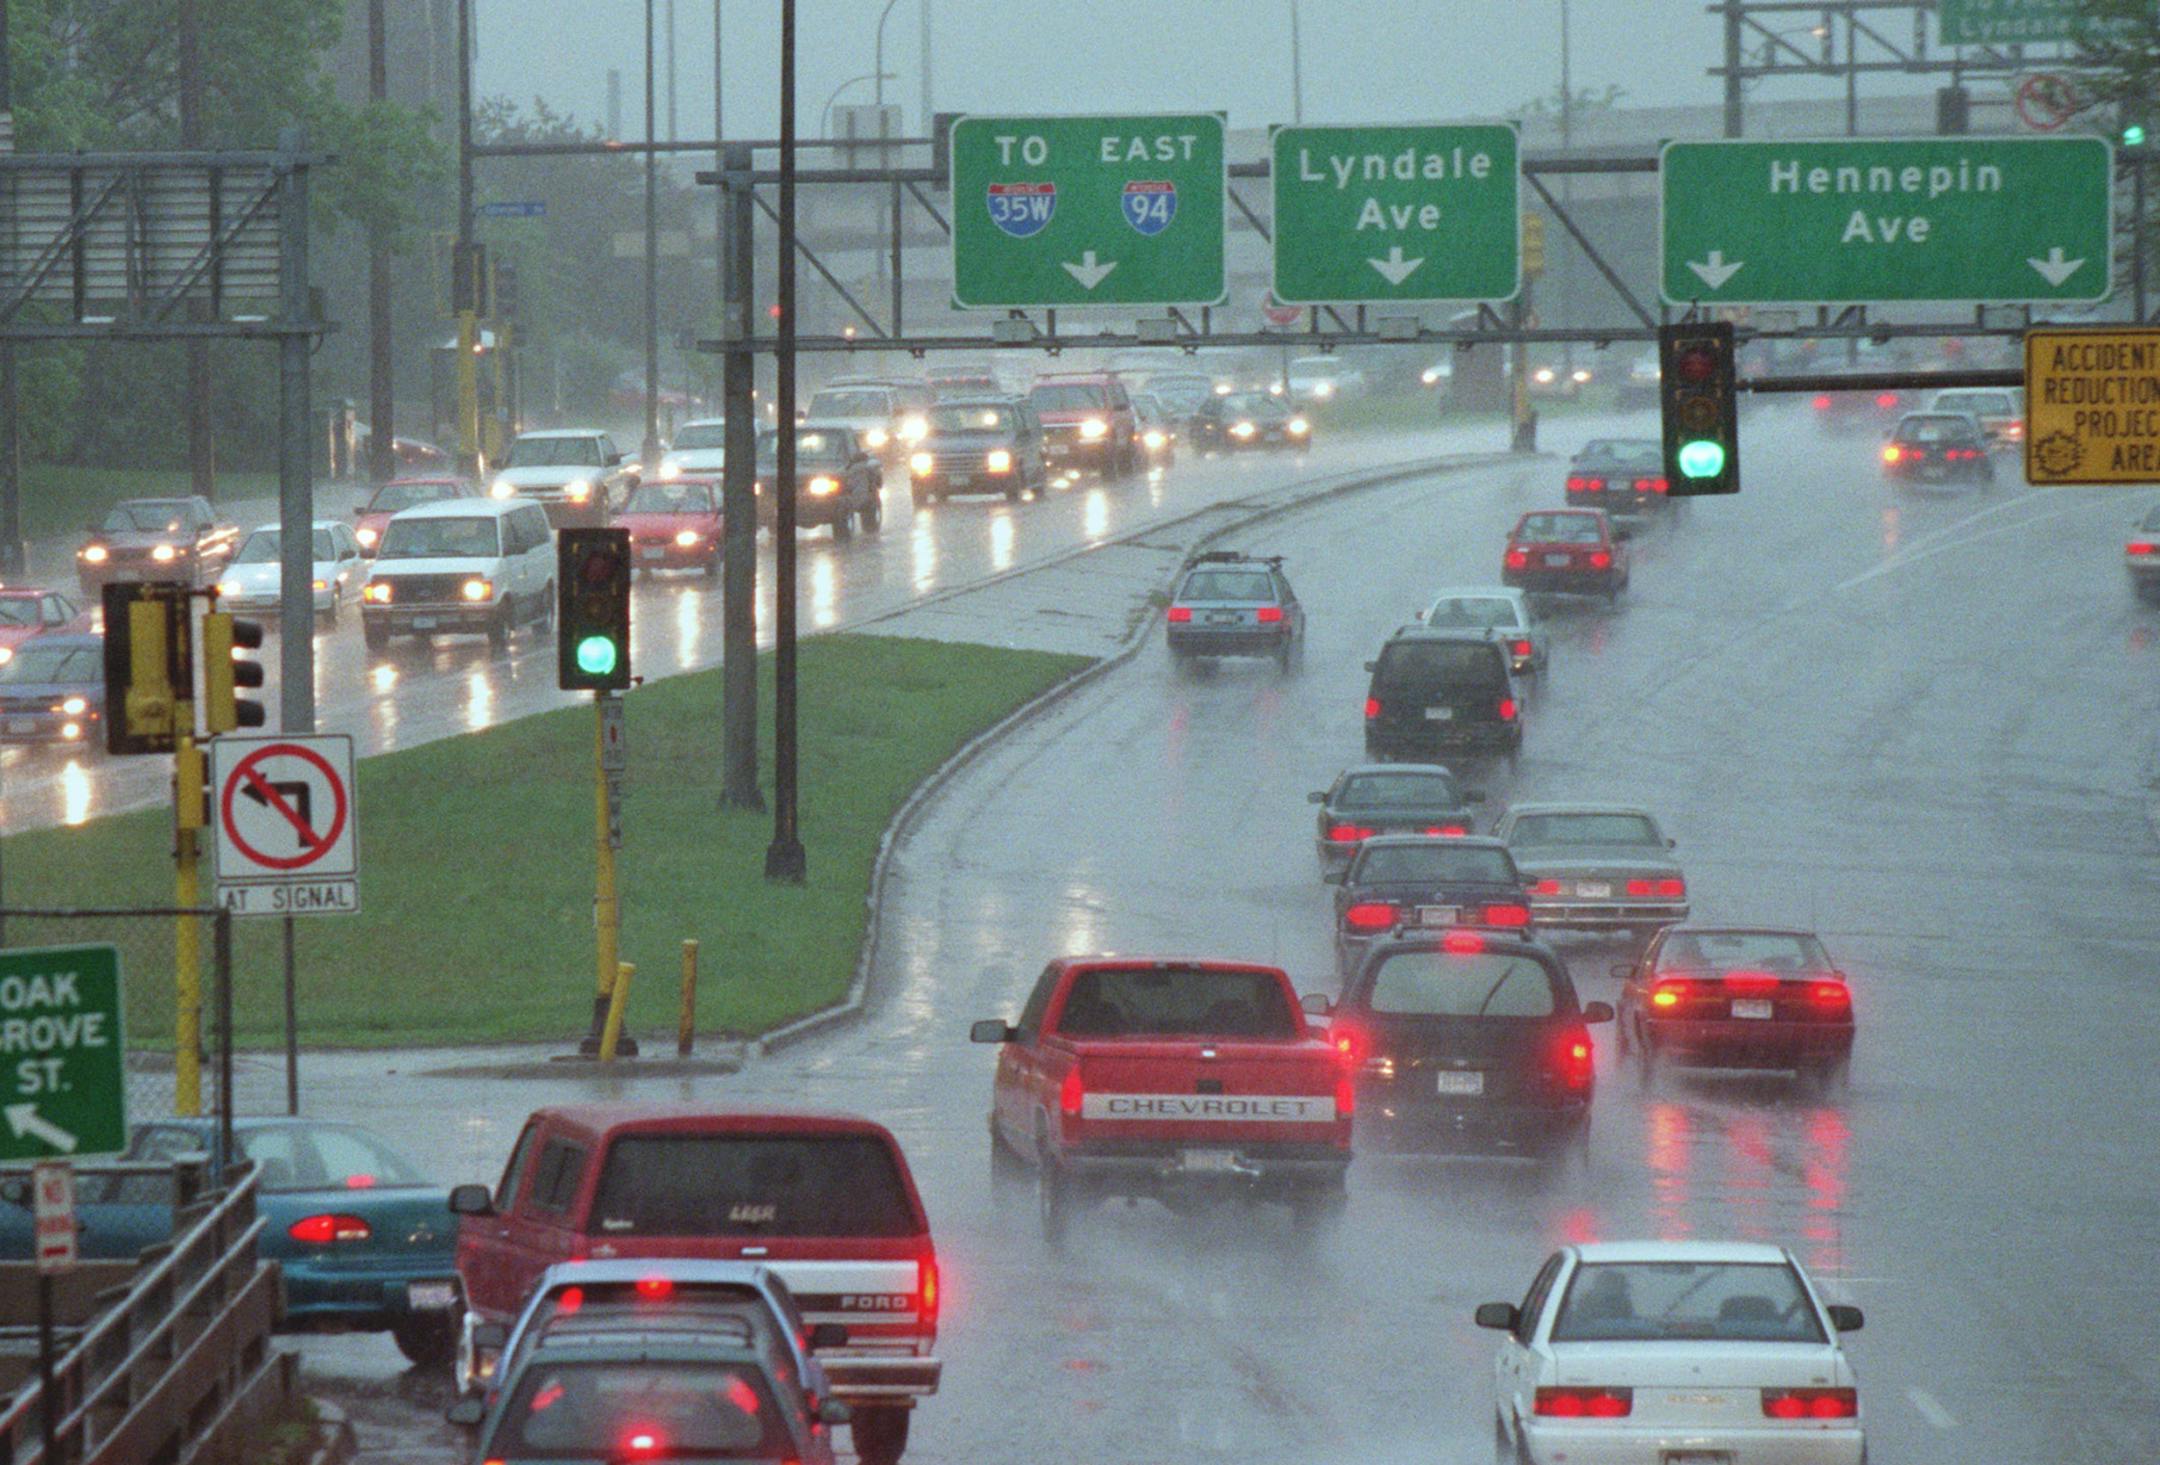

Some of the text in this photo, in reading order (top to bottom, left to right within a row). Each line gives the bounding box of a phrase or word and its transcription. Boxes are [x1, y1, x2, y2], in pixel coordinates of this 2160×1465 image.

[994, 134, 1198, 166] TO EAST
[1299, 146, 1492, 190] Lyndale
[1769, 158, 2003, 199] Hennepin
[994, 195, 1050, 223] 35W
[1131, 194, 1169, 225] 94
[1355, 197, 1441, 231] Ave
[1840, 210, 1931, 244] Ave
[2051, 342, 2158, 371] ACCIDENT
[2111, 444, 2160, 472] ARE
[225, 884, 348, 912] AT SIGNAL
[0, 972, 80, 1010] OAK
[0, 1012, 108, 1052] ROVE
[16, 1058, 72, 1094] ST.
[1108, 1098, 1314, 1117] CHEVROLET
[841, 1295, 909, 1309] FORD
